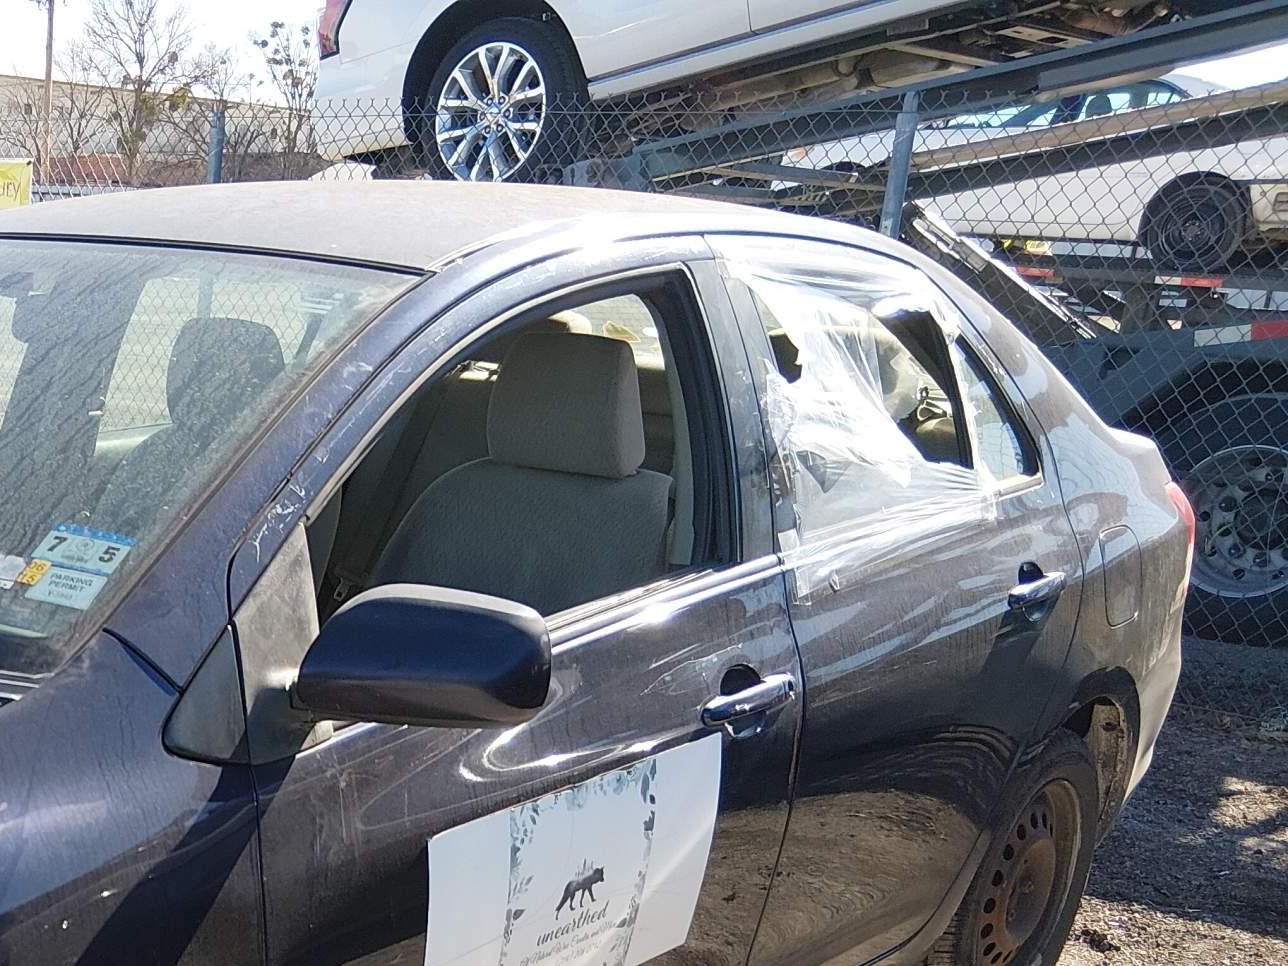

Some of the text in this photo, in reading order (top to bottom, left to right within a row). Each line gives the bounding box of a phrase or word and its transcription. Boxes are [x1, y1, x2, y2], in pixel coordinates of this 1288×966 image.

[48, 535, 68, 552] 7
[98, 545, 121, 563] 5
[47, 580, 86, 593] PERMIT
[50, 573, 95, 587] PARKING
[536, 899, 610, 947] unearthed
